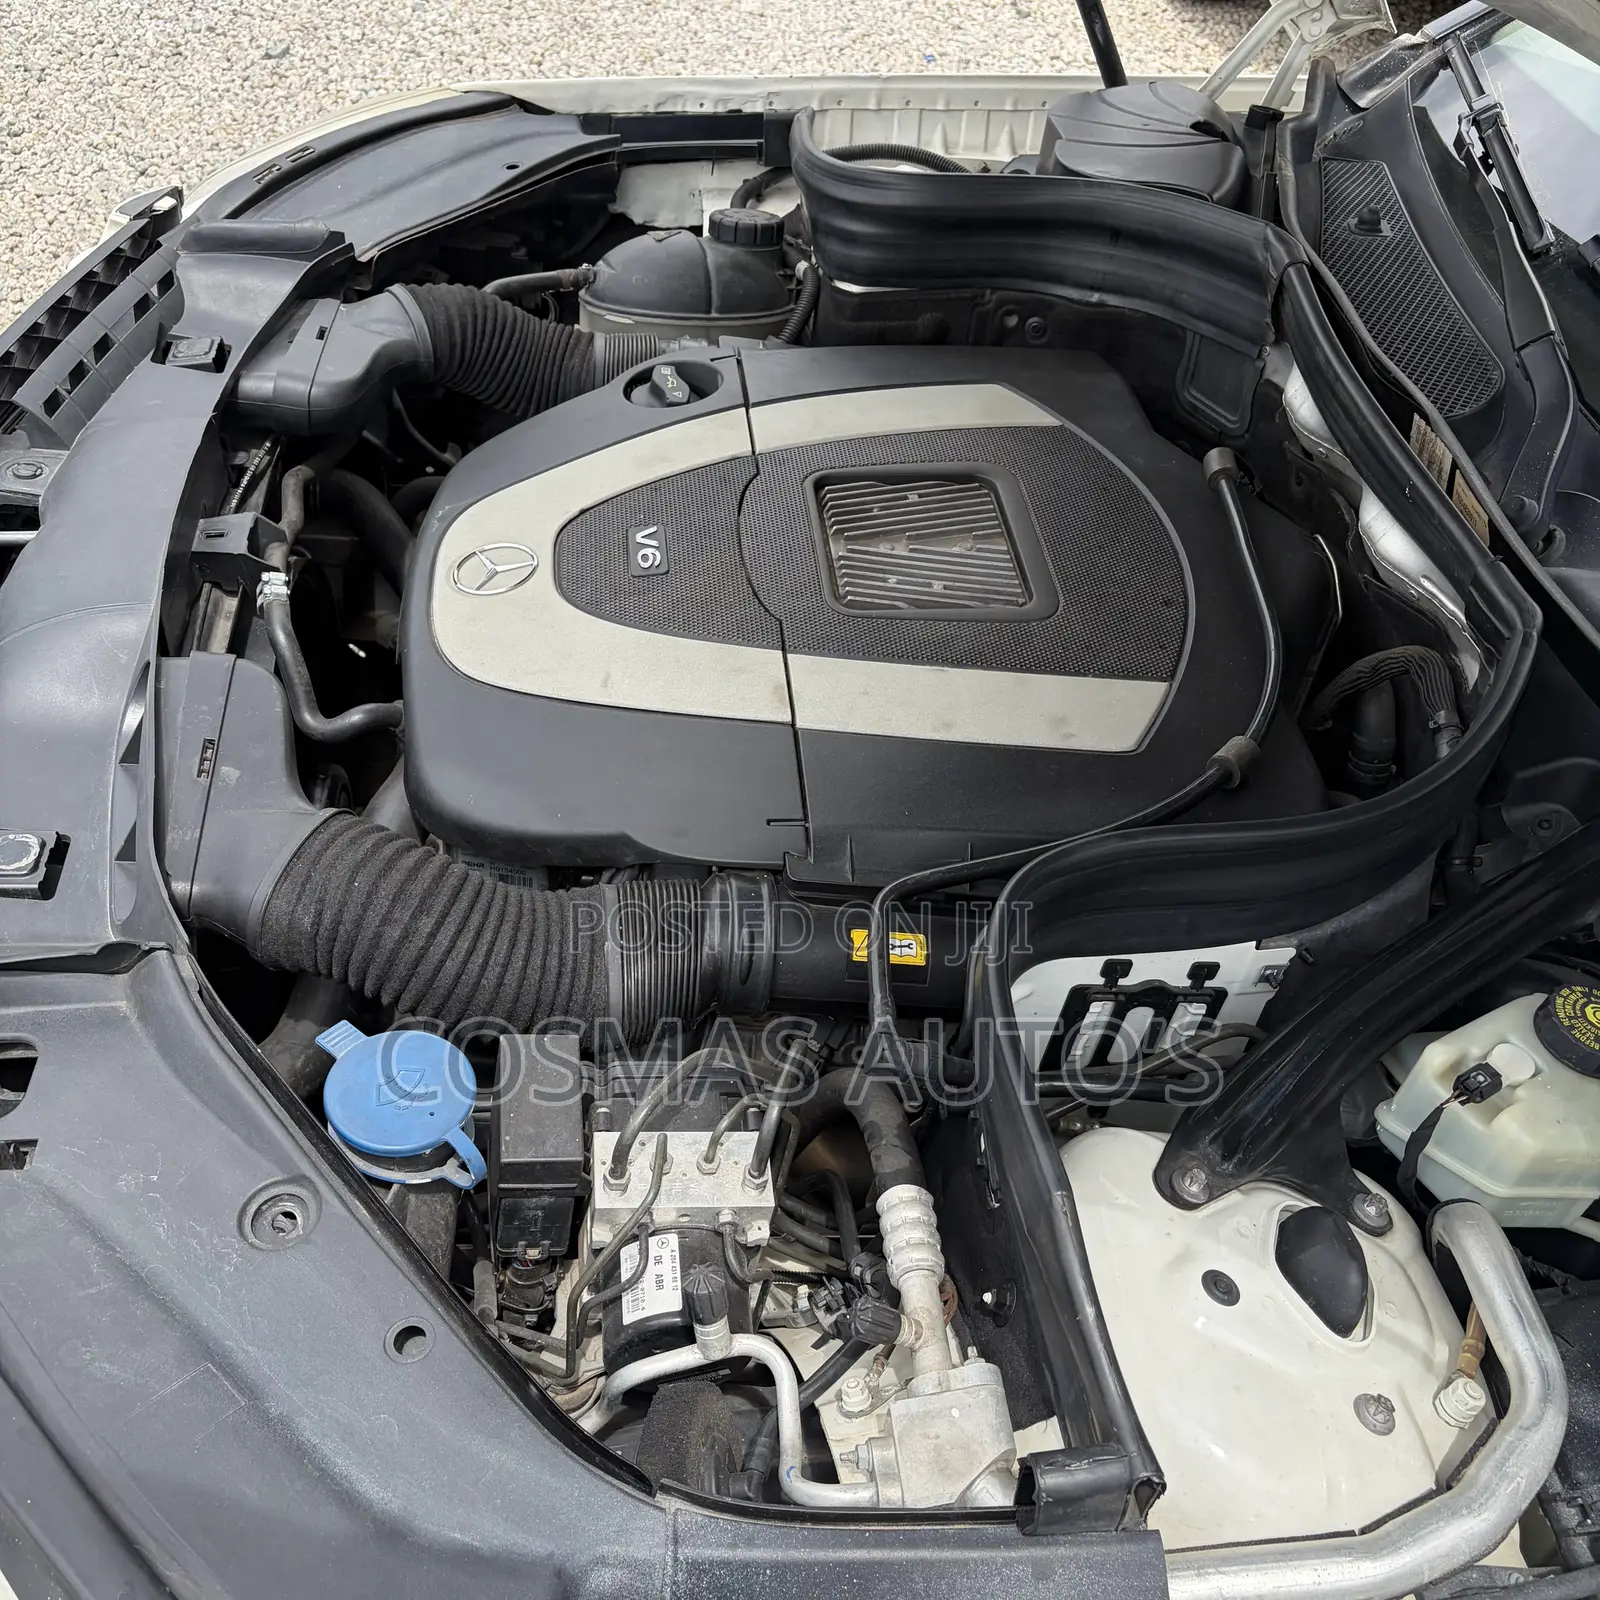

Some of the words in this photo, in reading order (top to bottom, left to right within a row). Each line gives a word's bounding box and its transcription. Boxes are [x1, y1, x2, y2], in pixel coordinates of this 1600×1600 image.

[635, 525, 661, 569] V6
[1570, 1019, 1596, 1040] SEALED
[1570, 1028, 1600, 1051] BEFORE
[653, 1254, 663, 1267] DE
[654, 1273, 665, 1292] ABR
